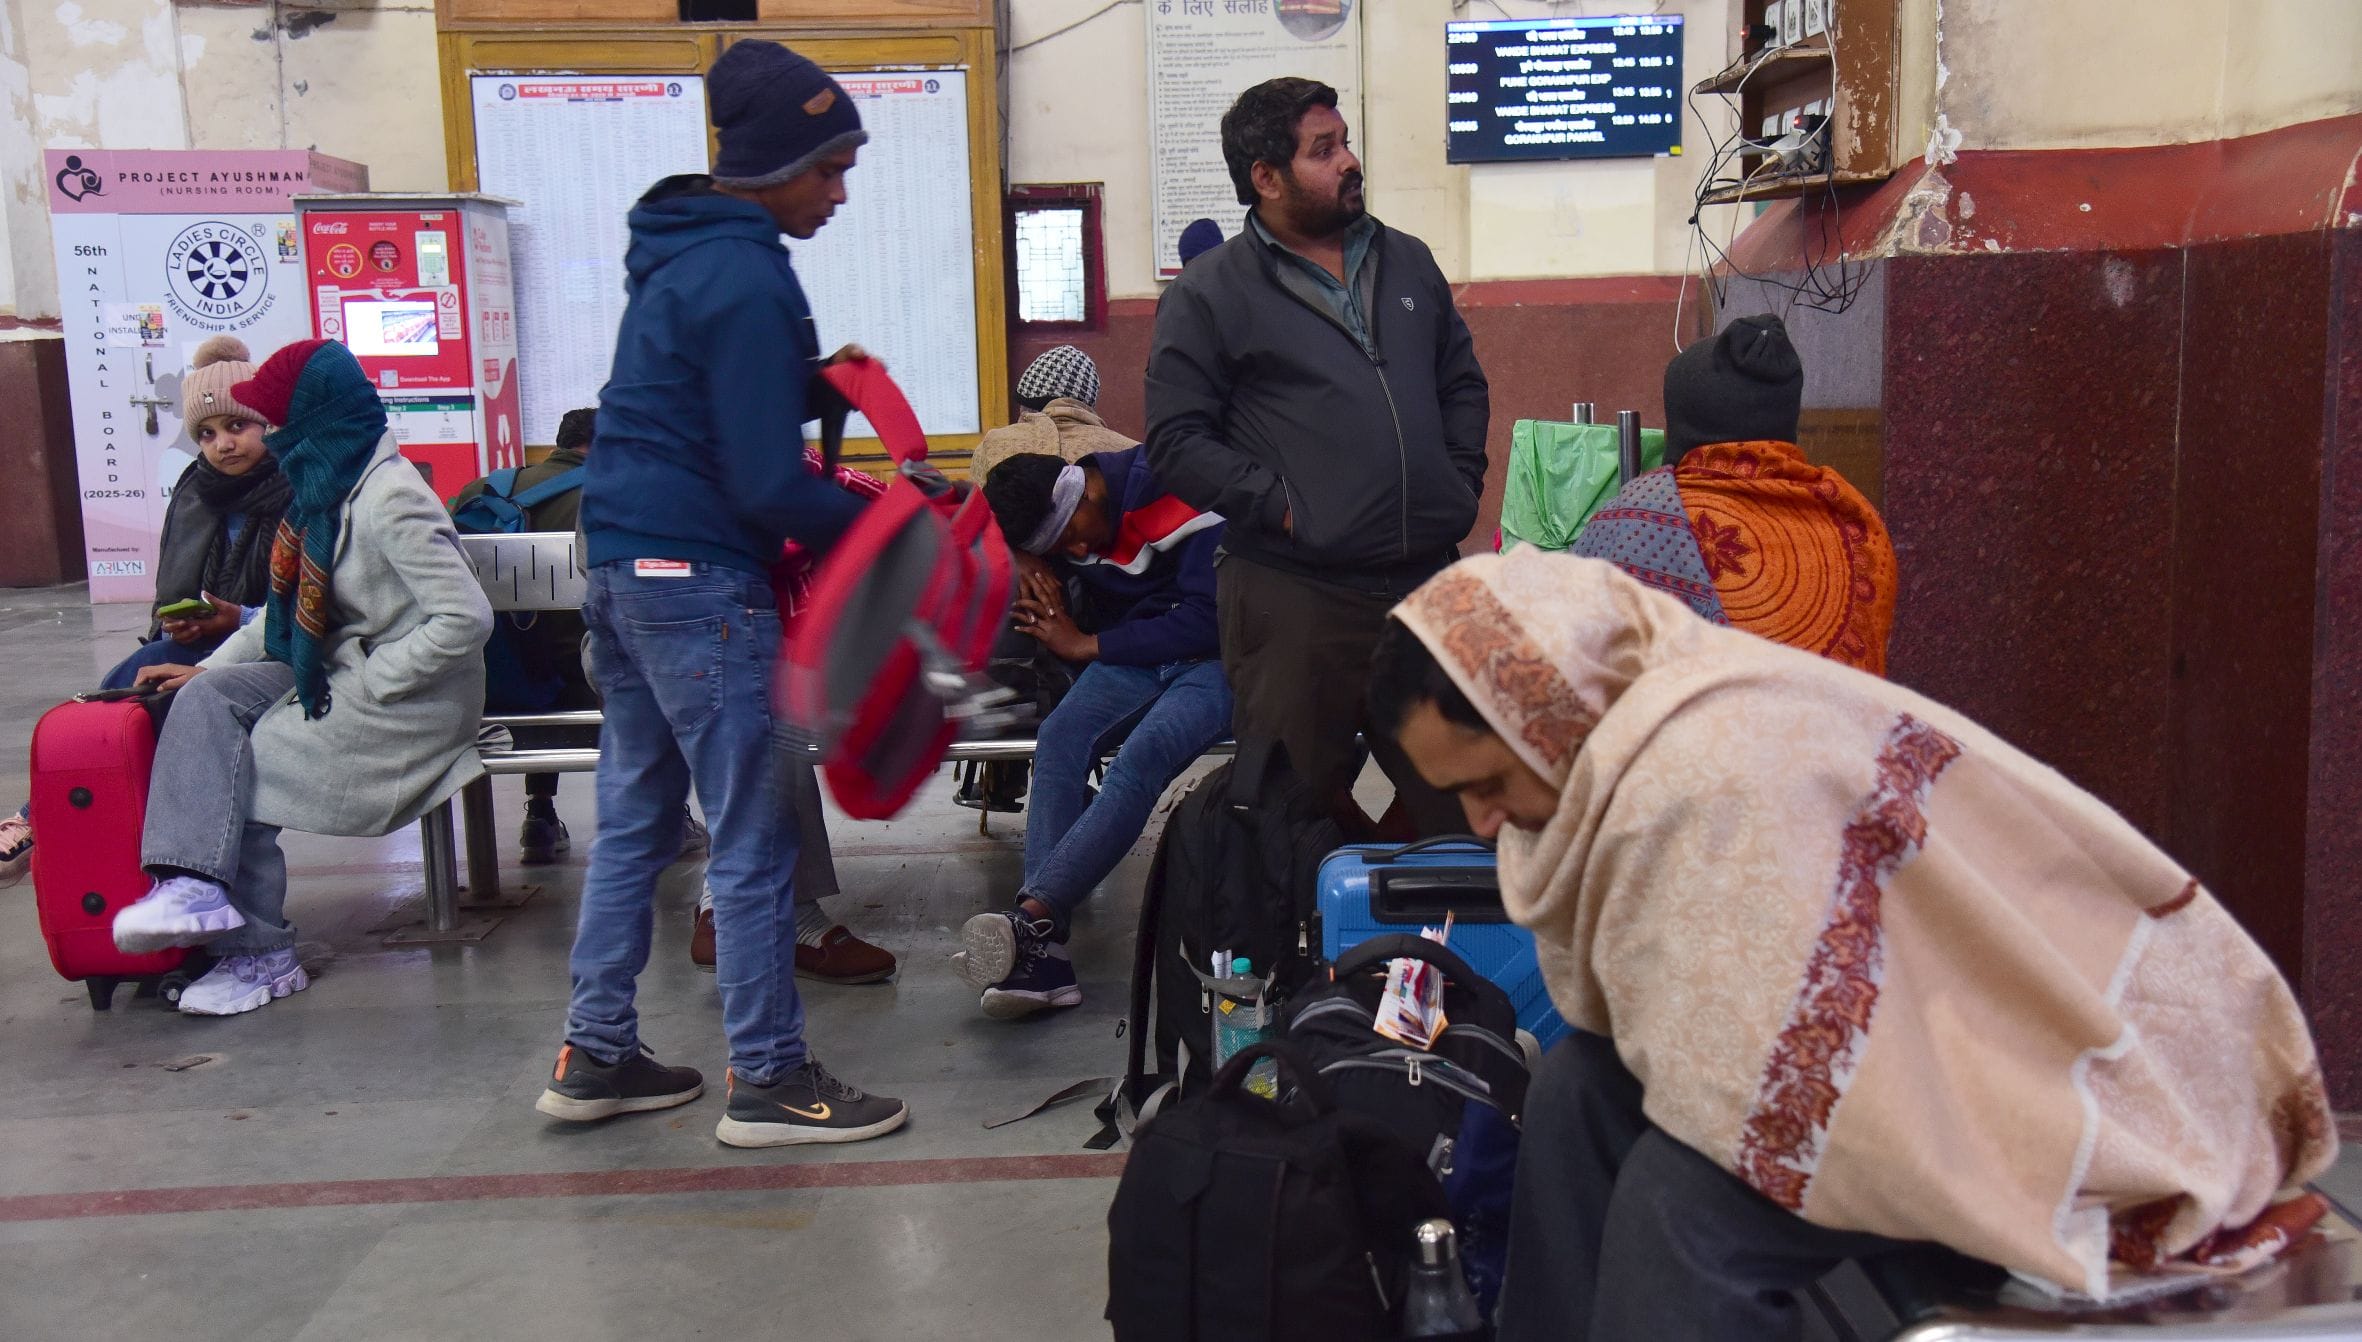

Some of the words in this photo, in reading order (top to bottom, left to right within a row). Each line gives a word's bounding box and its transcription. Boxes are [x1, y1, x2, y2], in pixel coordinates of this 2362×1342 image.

[119, 172, 199, 183] PROJECT
[210, 171, 304, 182] AYUSHMAN
[160, 187, 229, 196] (NURSING
[235, 187, 281, 195] ROOM)
[74, 245, 107, 257] 56th
[169, 227, 213, 271] LADIES
[219, 229, 266, 276] CIRCLE
[163, 292, 225, 332] FRIENDSHIP
[238, 292, 277, 329] SERVICE
[196, 299, 244, 314] INDIA
[102, 411, 118, 483] BOARD
[84, 489, 145, 499] (2025-26)
